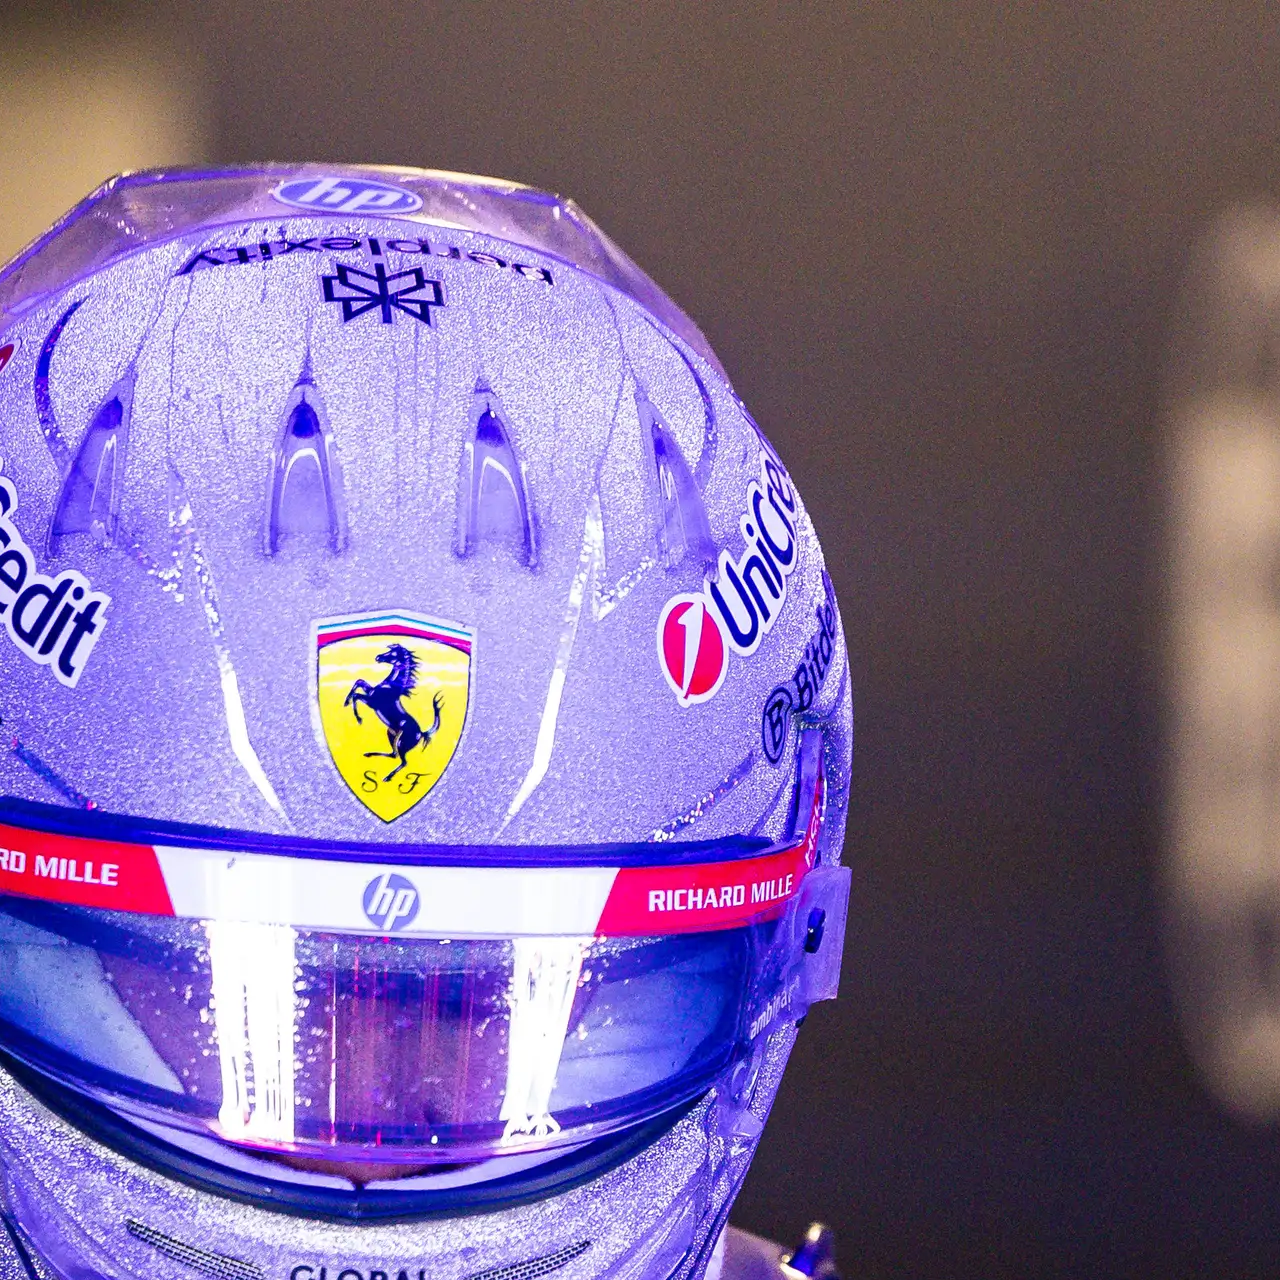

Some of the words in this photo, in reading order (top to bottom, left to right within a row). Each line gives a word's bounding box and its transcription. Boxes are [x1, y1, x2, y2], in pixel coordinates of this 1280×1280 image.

[297, 177, 405, 211] hp
[174, 231, 554, 286] perplexity
[793, 572, 836, 713] Bitde
[361, 770, 378, 793] S
[397, 772, 433, 795] F
[34, 854, 120, 887] MILLE
[366, 872, 418, 931] hp
[648, 882, 745, 912] RICHARD
[750, 873, 793, 901] MILLE
